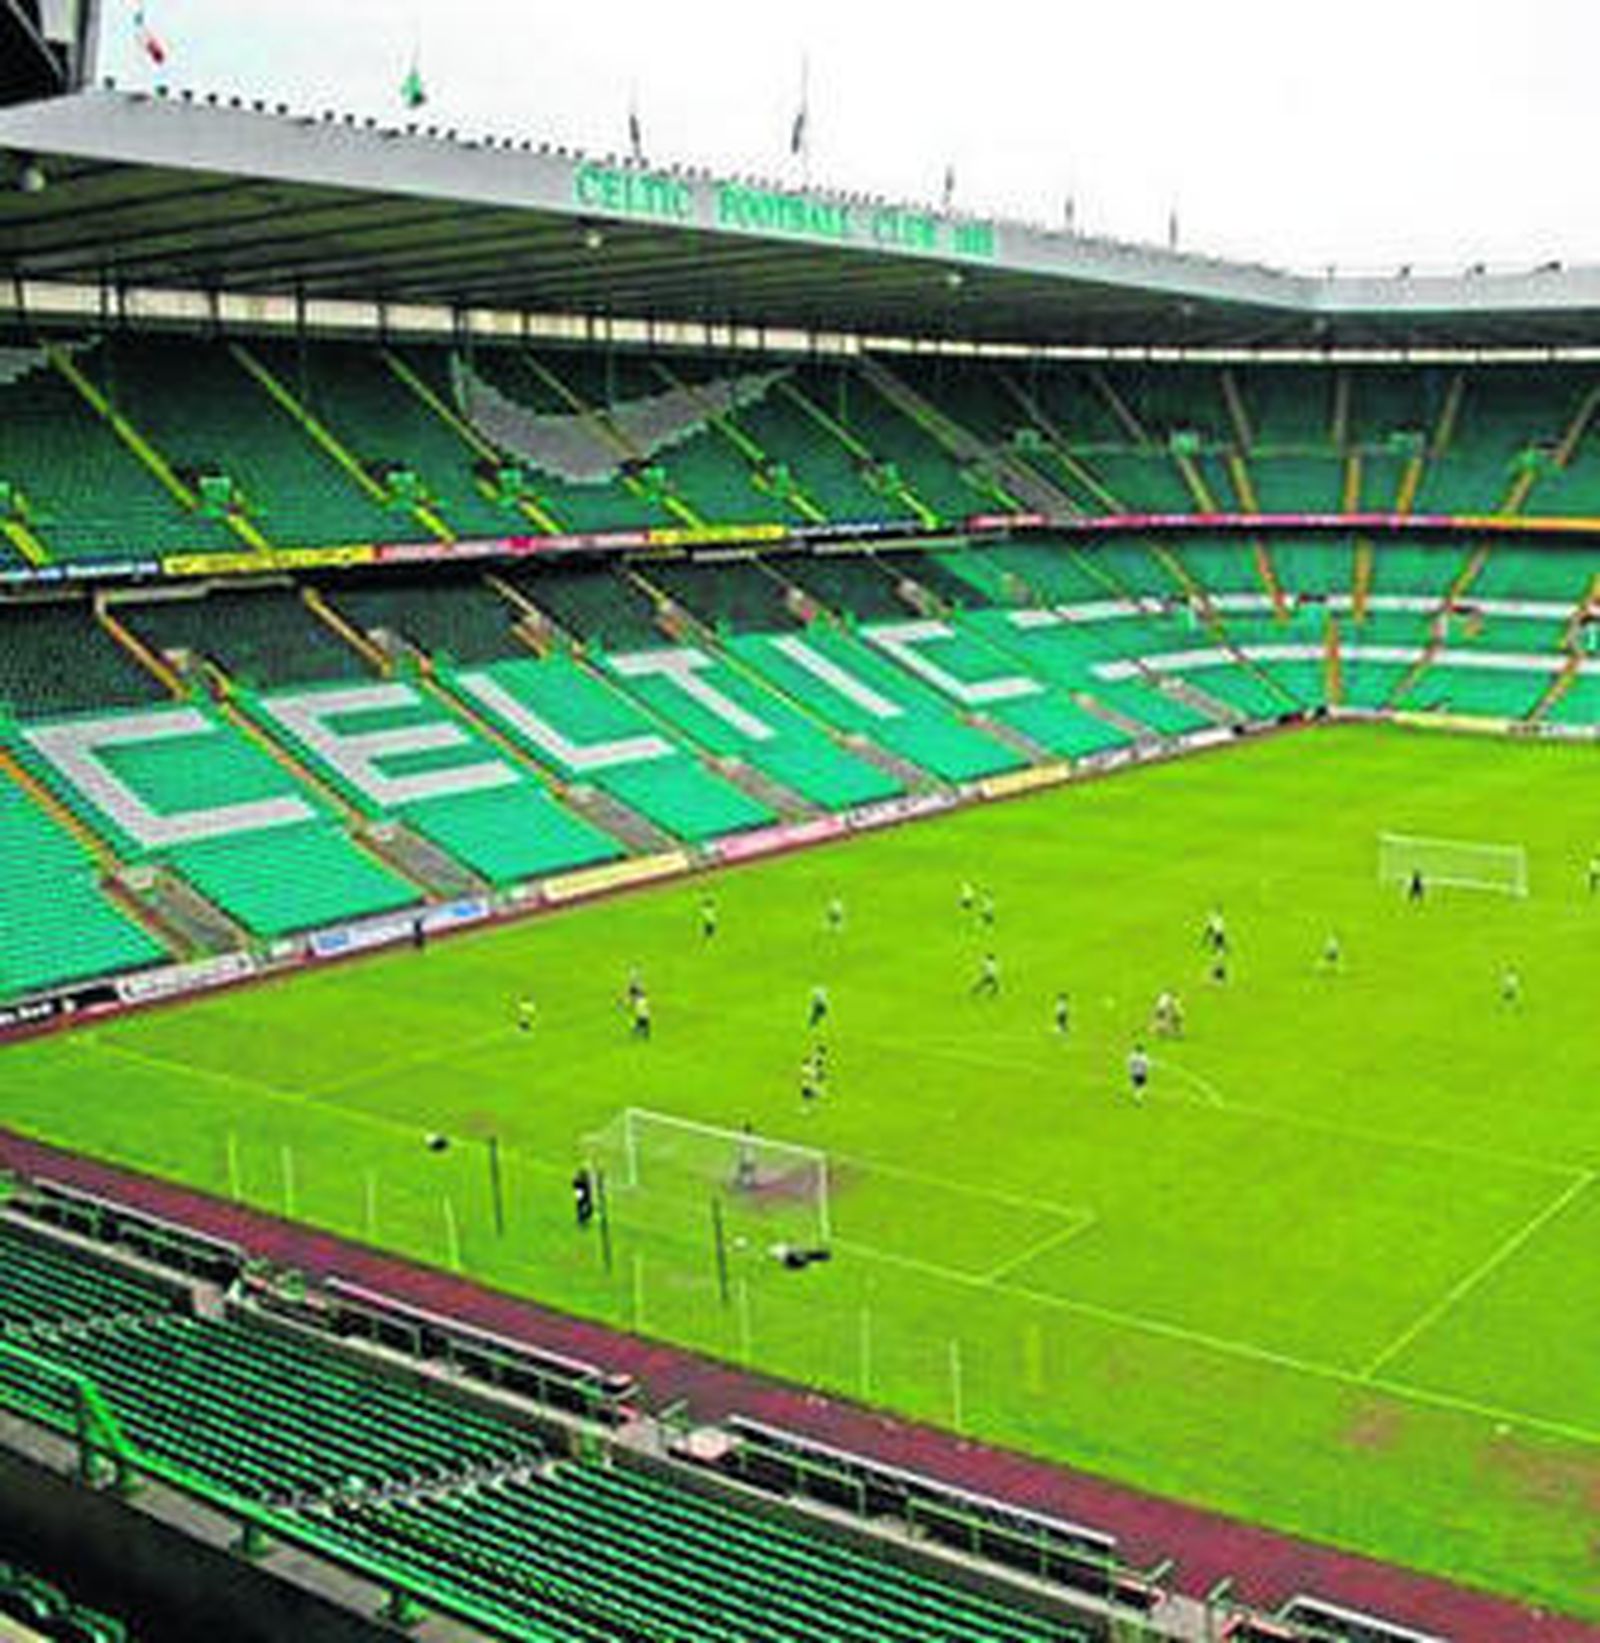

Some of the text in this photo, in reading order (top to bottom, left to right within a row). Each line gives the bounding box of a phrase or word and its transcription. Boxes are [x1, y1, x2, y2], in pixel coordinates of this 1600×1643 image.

[575, 165, 692, 219] CELTIC
[717, 184, 848, 238] FOOTBALL
[20, 620, 1044, 850] CELTIC
